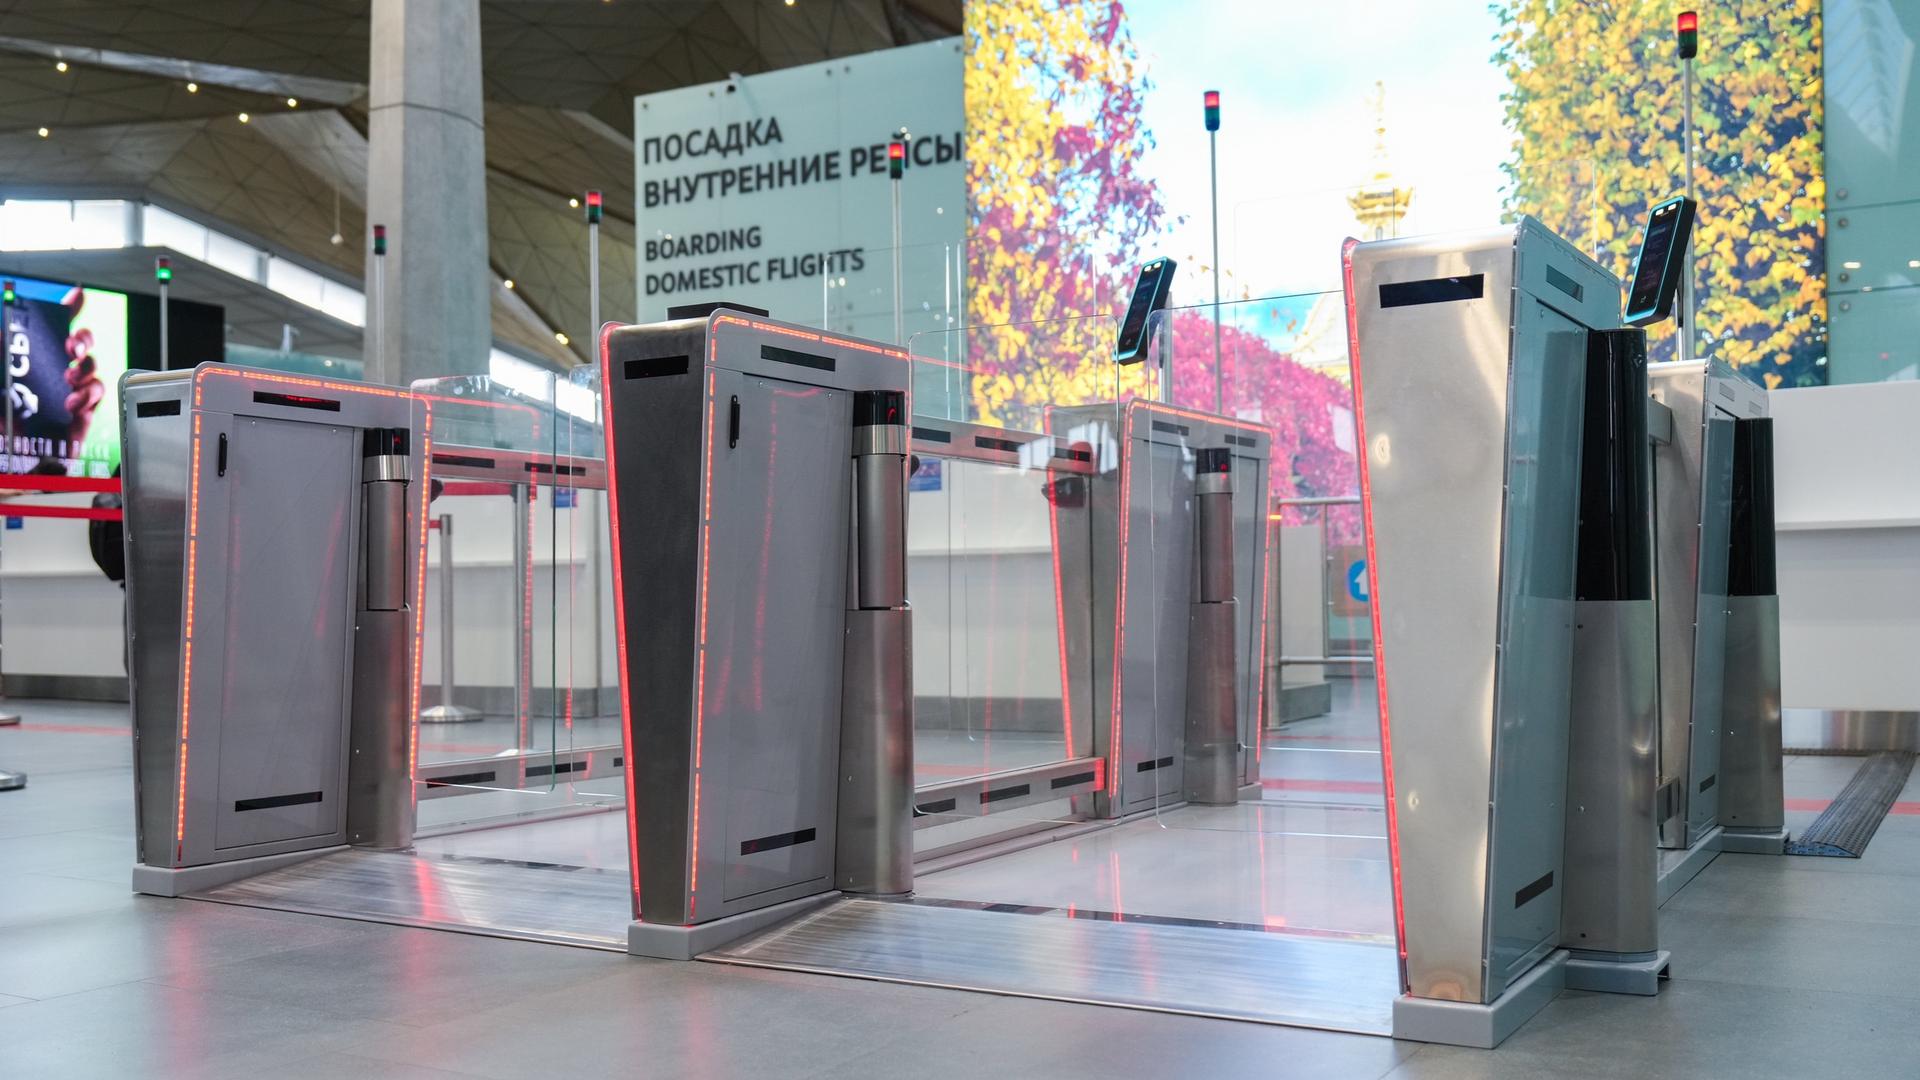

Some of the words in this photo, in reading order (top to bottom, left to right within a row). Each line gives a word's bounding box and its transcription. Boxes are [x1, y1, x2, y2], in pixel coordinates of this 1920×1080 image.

[644, 116, 783, 165] ПОСАДКА
[644, 150, 842, 209] ВНУТРЕННИЕ
[645, 226, 762, 262] BOARDING
[645, 262, 761, 296] DOMESTIC
[767, 248, 865, 282] FLIGHTS
